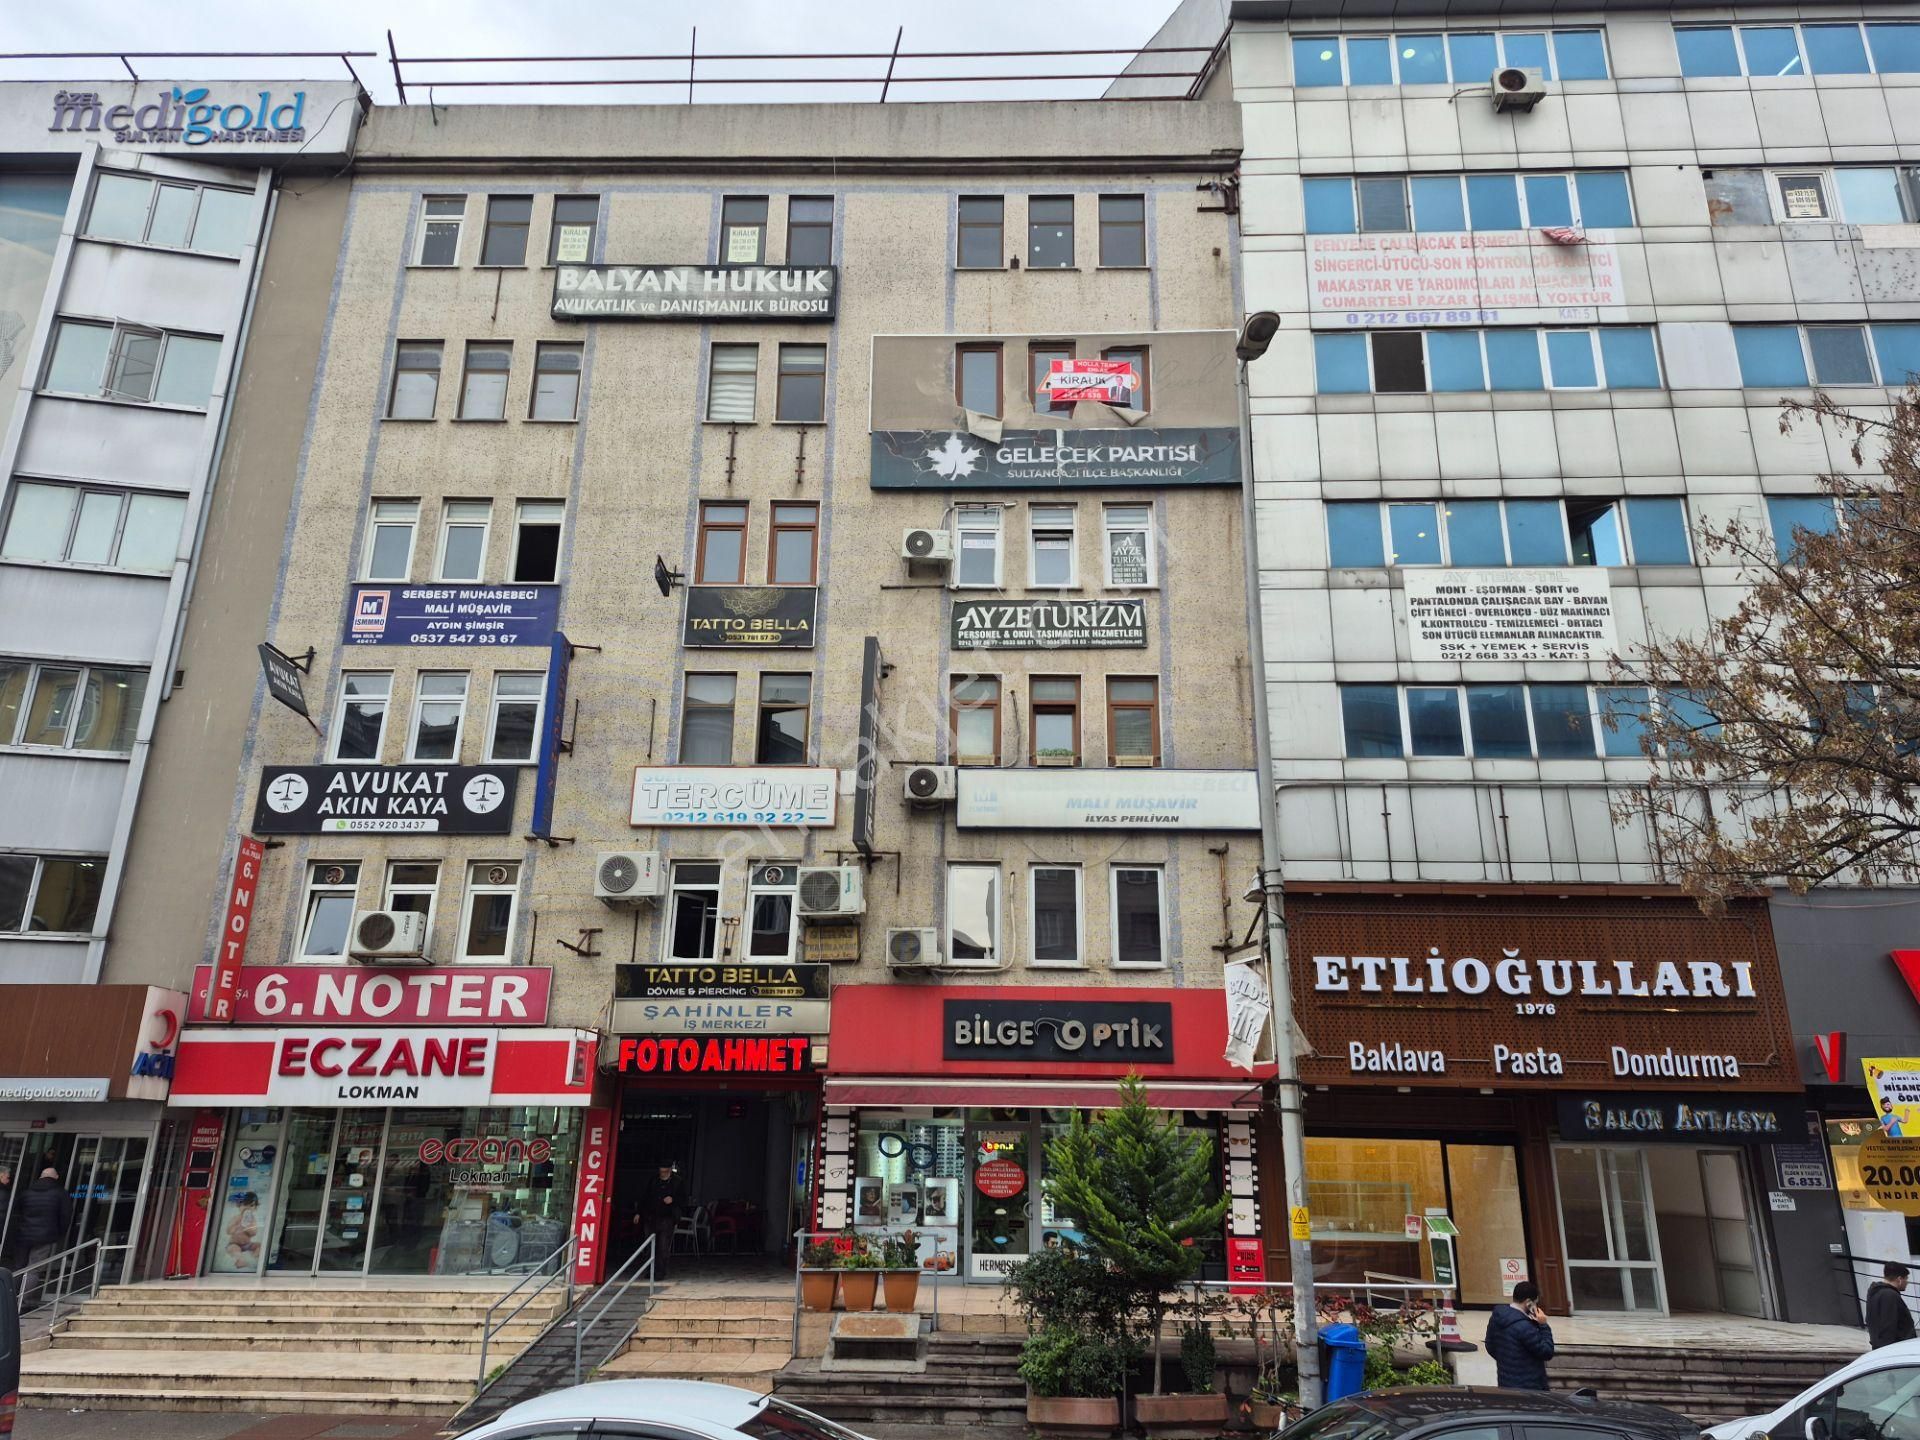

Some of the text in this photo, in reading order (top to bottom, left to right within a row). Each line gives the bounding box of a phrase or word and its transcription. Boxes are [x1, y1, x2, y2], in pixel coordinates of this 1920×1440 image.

[53, 90, 102, 106] ÖZEL
[48, 90, 306, 145] medigold
[115, 127, 306, 143] SULTAN HASTANESİ
[558, 269, 829, 292] BALYAN HUKUK
[1317, 280, 1396, 293] MAKASTAR
[1399, 280, 1414, 292] VE
[554, 296, 829, 315] AVUKATLIK ve DANIŞMANLIK BÜROSU
[1322, 292, 1412, 309] CUMARTESİ
[1417, 294, 1466, 307] PAZAR
[1547, 290, 1612, 304] YOKTUR
[1366, 312, 1399, 325] 212
[1405, 312, 1441, 324] 667
[1583, 309, 1590, 319] 5
[1060, 375, 1107, 385] KİRALIK
[1109, 444, 1198, 463] PARTİSİ
[1082, 465, 1108, 479] İLÇE
[1110, 464, 1183, 478] BAŞKANLIĞI
[1111, 546, 1142, 556] AYZE
[402, 589, 538, 600] SERBEST MUHASEBECİ
[1436, 586, 1467, 594] MONT
[1535, 585, 1563, 596] ŞORT
[1410, 596, 1608, 607] PANTALONDA ÇALIŞACAK BAY BAYAN
[425, 603, 513, 615] MALİ MÜŞAVİR
[1411, 607, 1431, 617] ÇİFT
[1540, 607, 1559, 616] DÜZ
[1561, 606, 1611, 616] MAKİNACI
[427, 621, 505, 631] AYDIN ŞİMŞİR
[690, 618, 809, 631] TATTO BELLA
[1496, 617, 1559, 629] TEMİZLEMECİ
[1567, 619, 1603, 628] ORTACI
[410, 634, 518, 643] 0537 547 93 67
[958, 629, 1143, 640] PERSONEL & OKUL TAŞIMACILIK HİZMETLERİ
[1422, 631, 1442, 640] SON
[1444, 629, 1477, 640] ÜTÜCÜ
[1480, 631, 1536, 639] ELEMANLAR
[1440, 643, 1466, 651] SSK
[1542, 641, 1590, 650] SERVİS
[1441, 652, 1590, 660] 0212 668 33 43 KAT: 3
[326, 771, 449, 794] AVUKAT
[642, 779, 829, 810] TERCÜME
[317, 797, 448, 815] AKIN KAYA
[662, 812, 805, 824] 0212 619 92 22
[1085, 813, 1180, 823] İLYAS PEHLİVAN
[350, 820, 376, 830] 0552
[378, 820, 399, 830] 920
[242, 861, 254, 880] 6.
[215, 888, 250, 1018] NOTER
[645, 968, 798, 984] TATTO BELLA
[1313, 946, 1757, 998] ETLİOĞULLARI
[647, 986, 686, 996] DÖVME
[688, 987, 695, 996] &
[643, 1003, 793, 1021] ŞAHİNLER
[1515, 1003, 1557, 1016] 1976
[684, 1019, 766, 1031] İŞ MERKEZİ
[954, 1012, 1034, 1046] BİLGE
[277, 1037, 488, 1078] ECZANE
[1349, 1040, 1741, 1079] Baklava Pasta Dondurma
[338, 1085, 419, 1099] LOKMAN
[1584, 1101, 1779, 1132] SALON AVRASYA
[419, 1138, 551, 1165] eczane
[450, 1168, 512, 1183] Lokman
[578, 1127, 603, 1267] ECZANE
